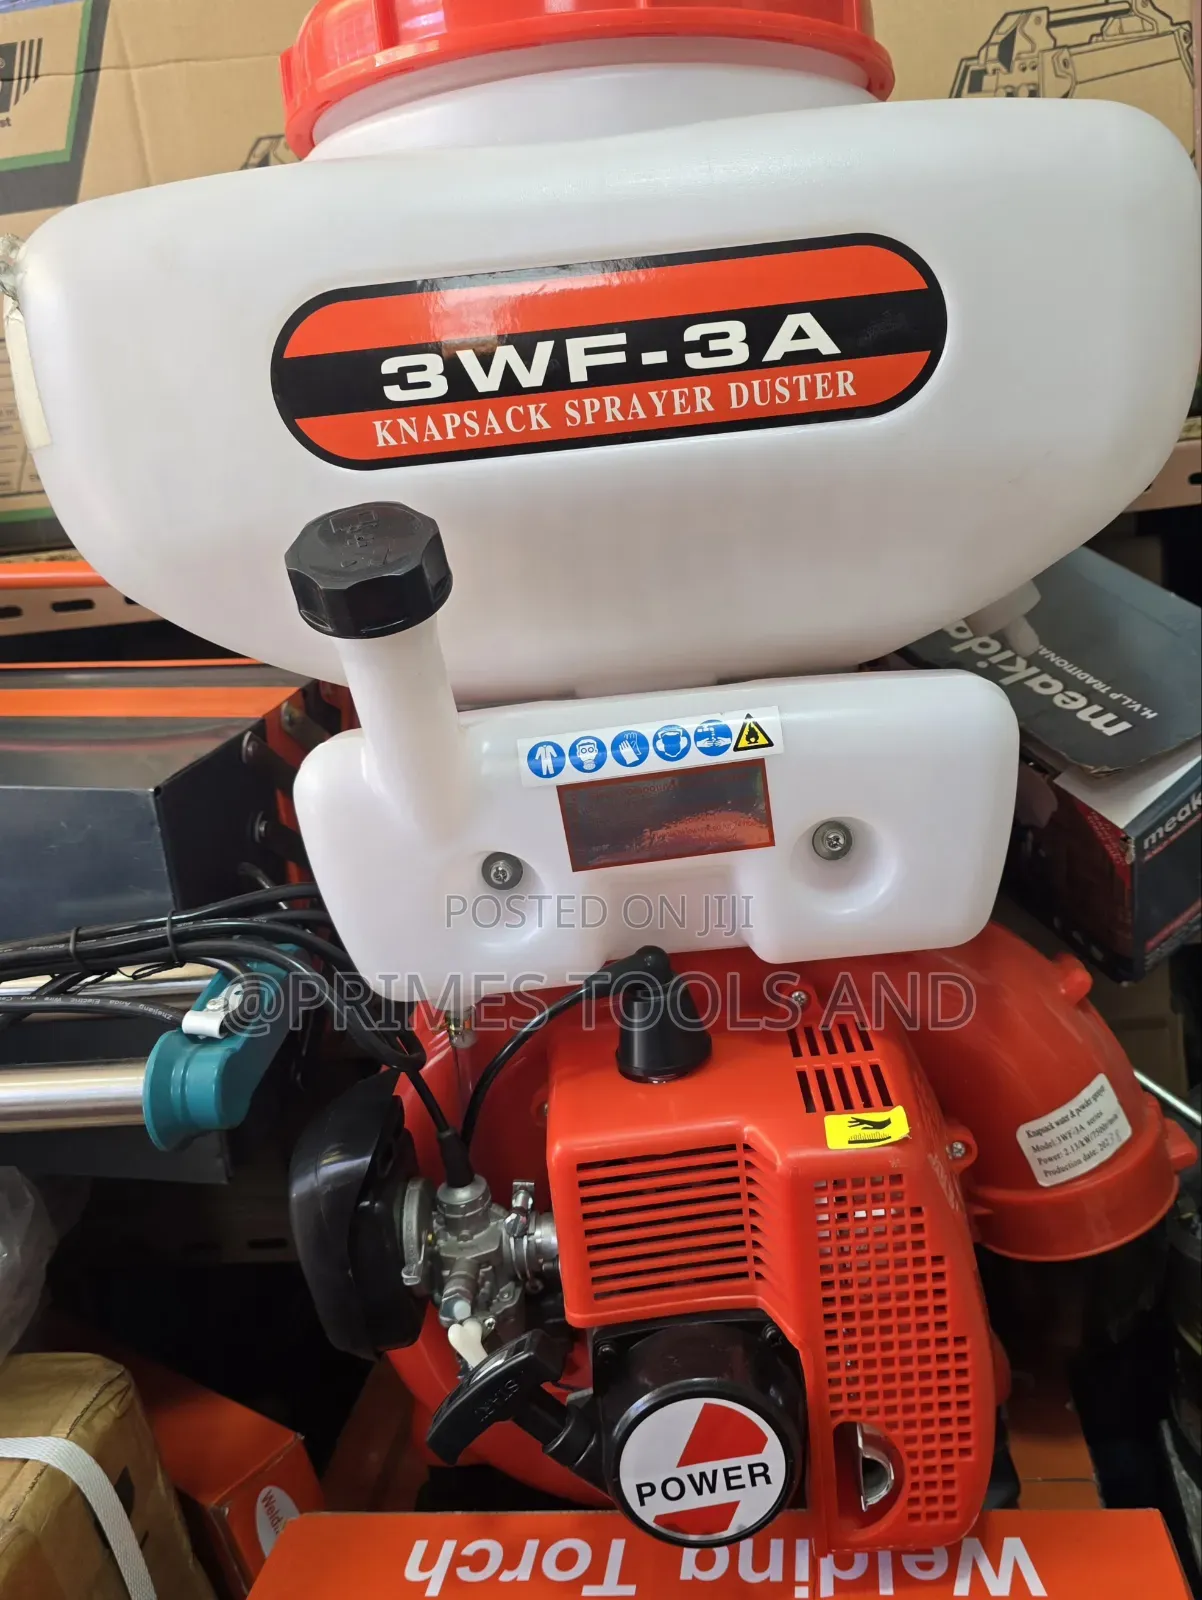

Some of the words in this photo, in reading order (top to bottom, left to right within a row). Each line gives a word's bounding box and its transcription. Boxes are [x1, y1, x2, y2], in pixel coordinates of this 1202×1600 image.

[380, 312, 841, 402] 3WF-3A
[372, 403, 551, 447] KNAPSACK
[565, 385, 715, 428] SPRAYER
[728, 370, 857, 409] DUSTER
[1038, 645, 1112, 693] TRADITIONA
[635, 1461, 772, 1508] POWER
[404, 1538, 637, 1598] Torch
